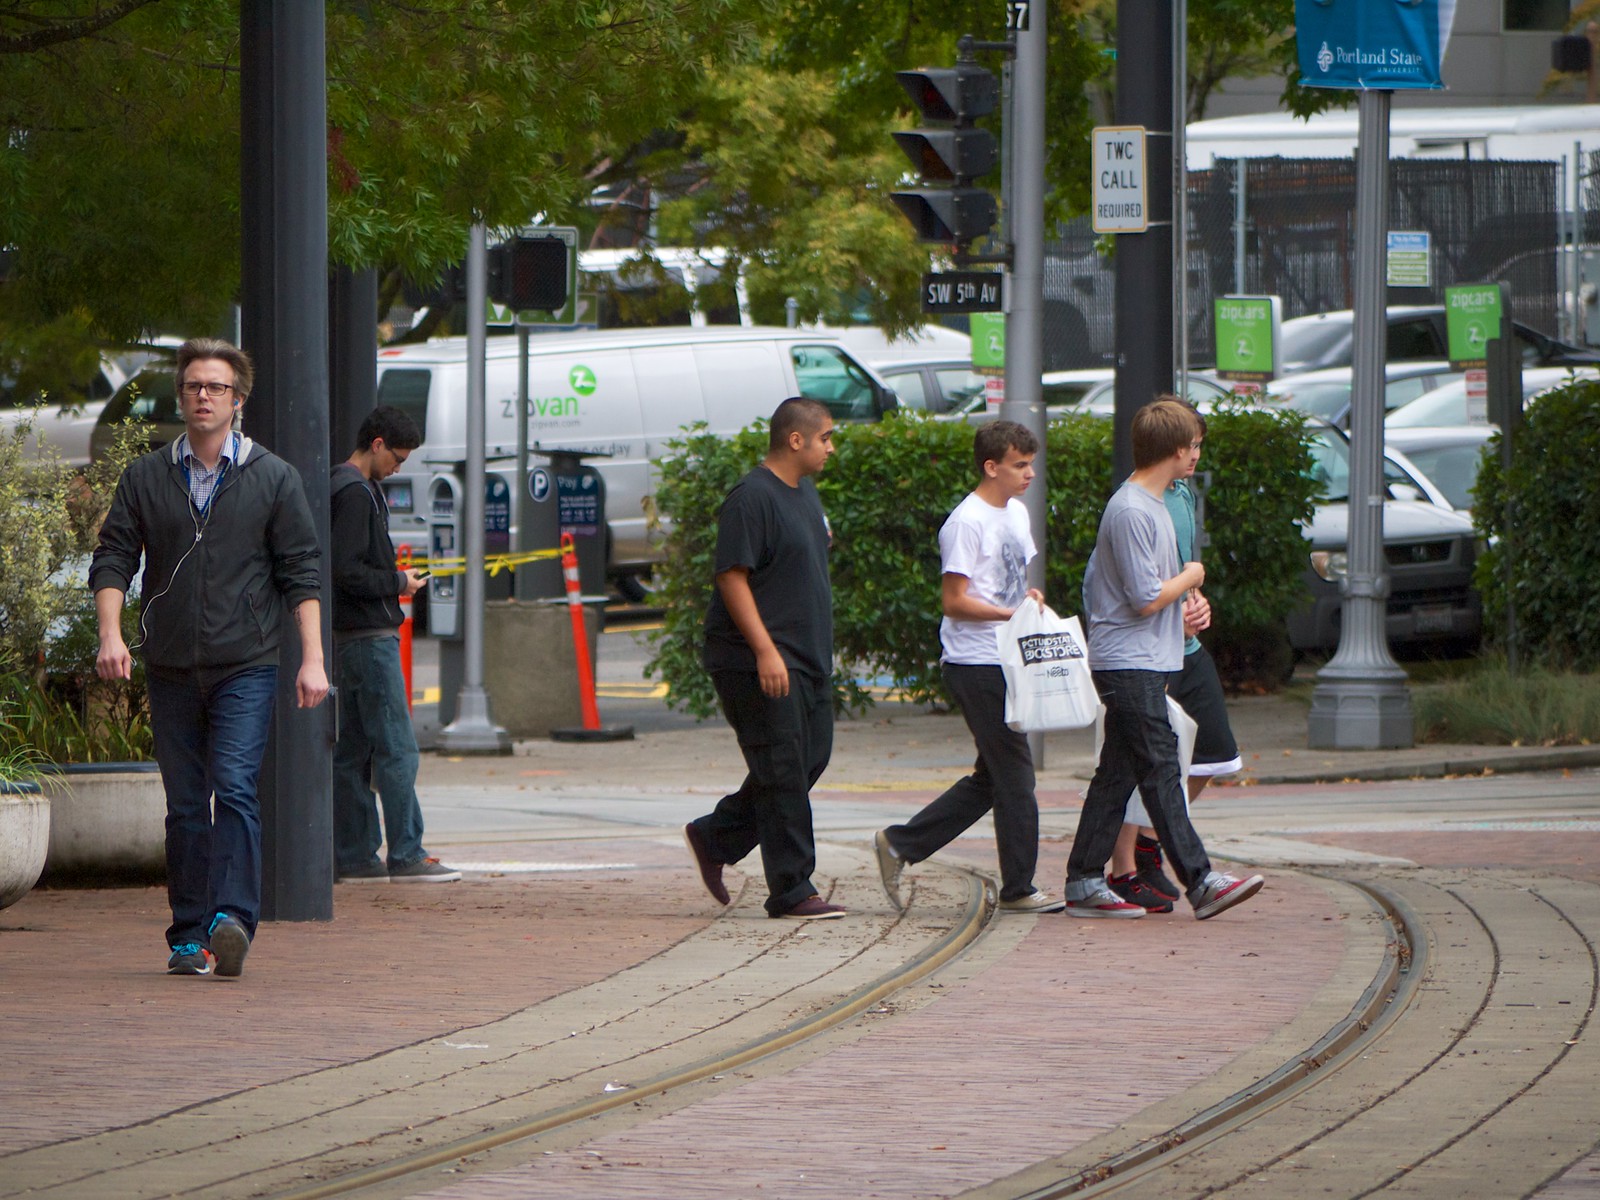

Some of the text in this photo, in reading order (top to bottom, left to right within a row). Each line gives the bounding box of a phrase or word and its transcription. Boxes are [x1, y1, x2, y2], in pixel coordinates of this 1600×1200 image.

[1336, 46, 1422, 65] Portland State
[1105, 141, 1133, 160] TWC
[1101, 170, 1137, 189] CALL
[1097, 203, 1141, 218] REQUIRED
[927, 282, 996, 304] SW 5th Av
[1451, 290, 1496, 309] zipcars
[1220, 306, 1266, 322] zipcars
[608, 442, 631, 458] day
[533, 473, 547, 497] P
[557, 475, 577, 491] Pay
